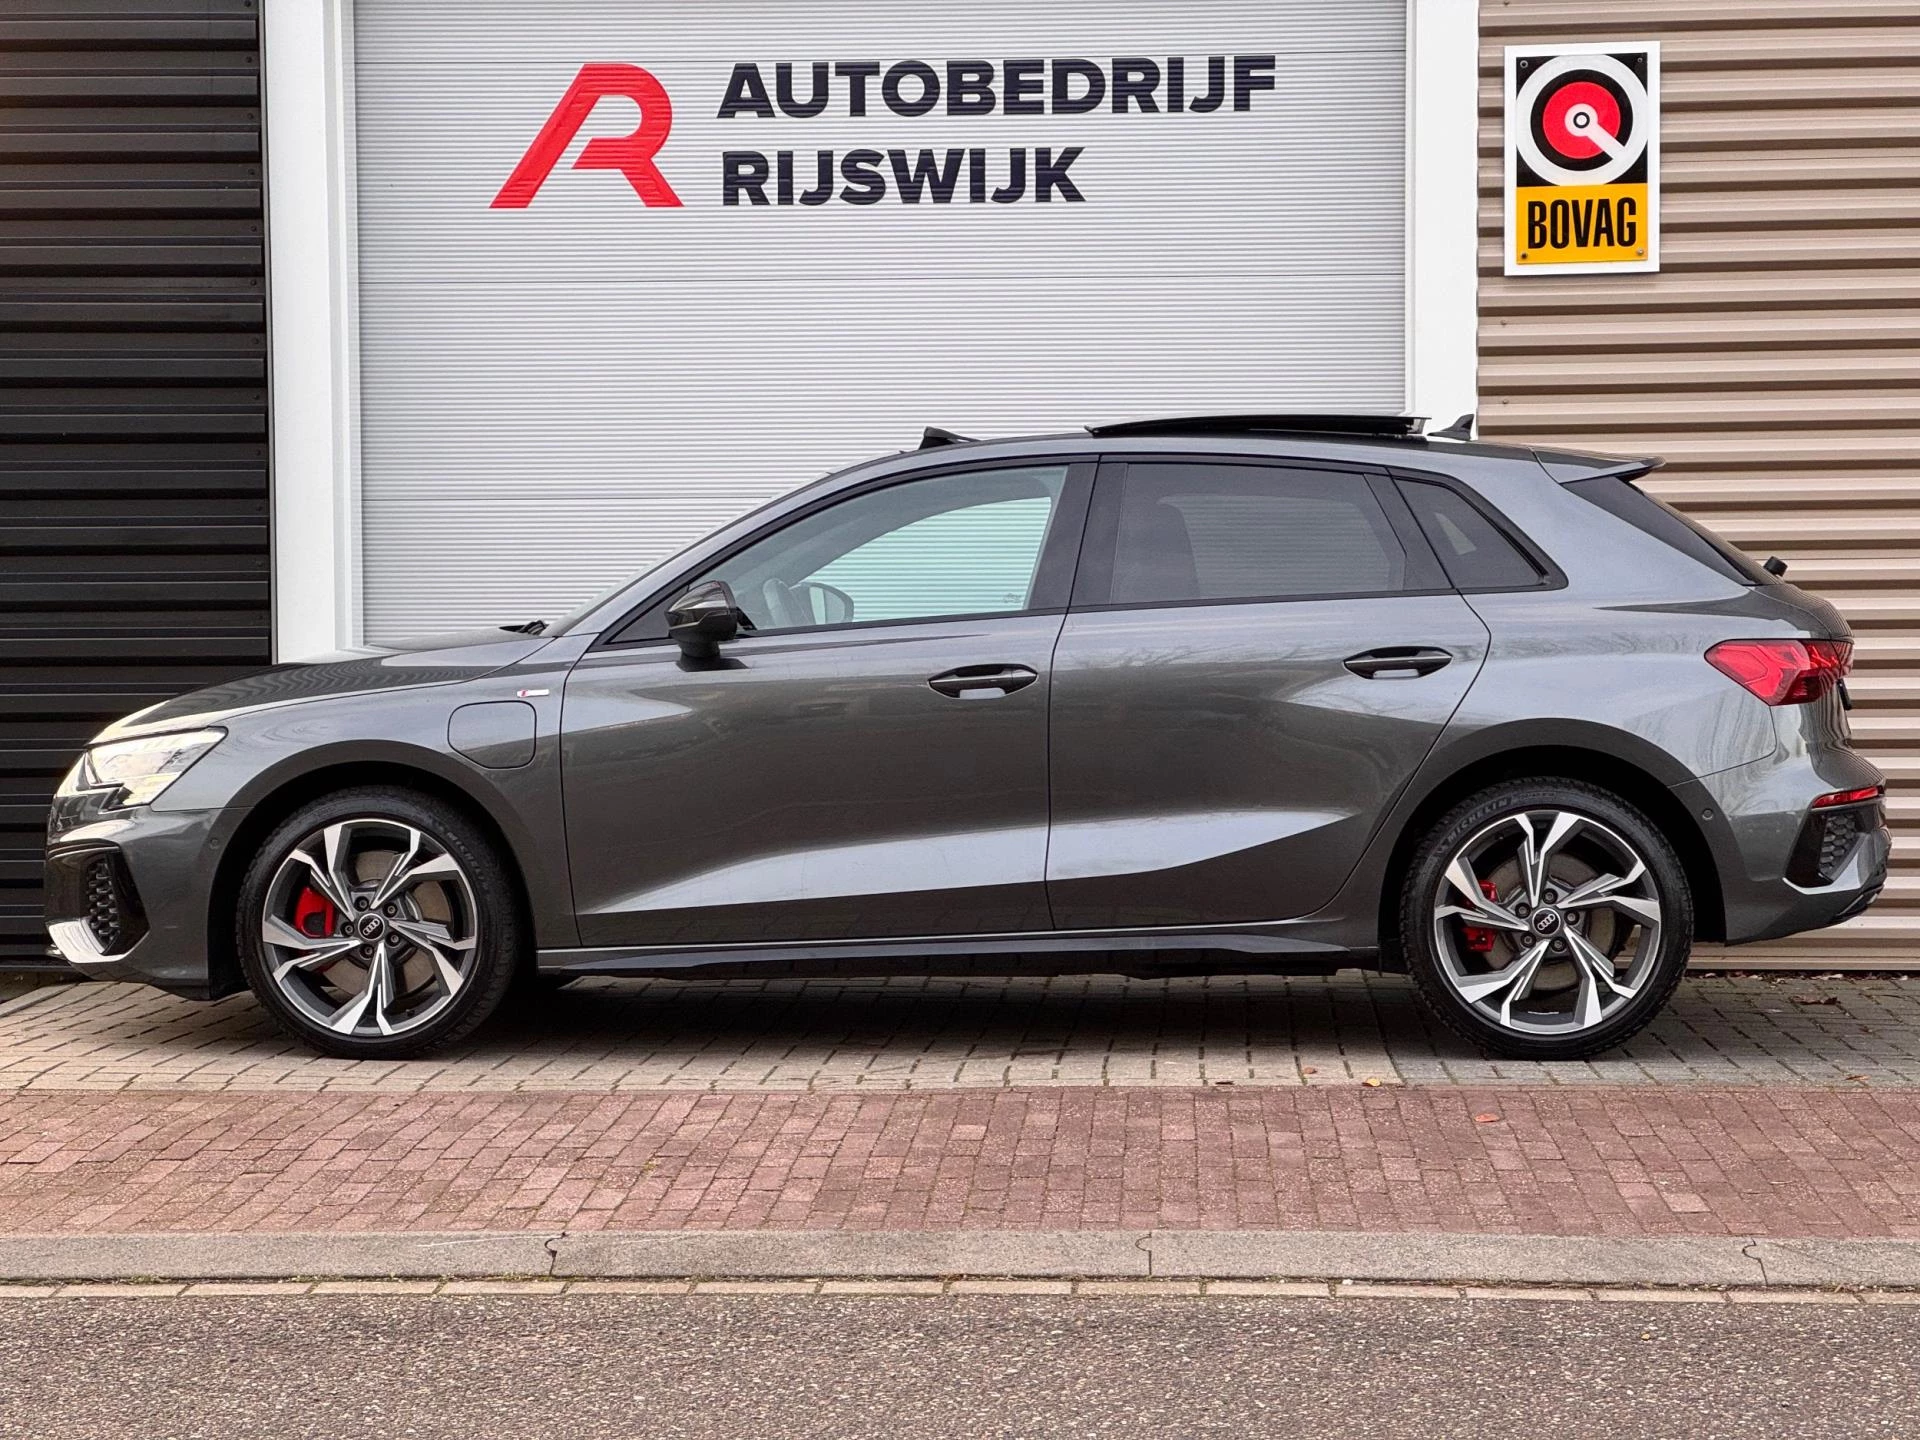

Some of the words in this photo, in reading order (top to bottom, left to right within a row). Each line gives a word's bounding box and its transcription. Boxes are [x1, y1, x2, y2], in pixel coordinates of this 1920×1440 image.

[716, 54, 1276, 118] AUTOBEDRIJF
[722, 147, 1086, 206] RIJSWIJK
[1527, 197, 1637, 249] BOVAG
[1448, 799, 1510, 842] MICHELIN
